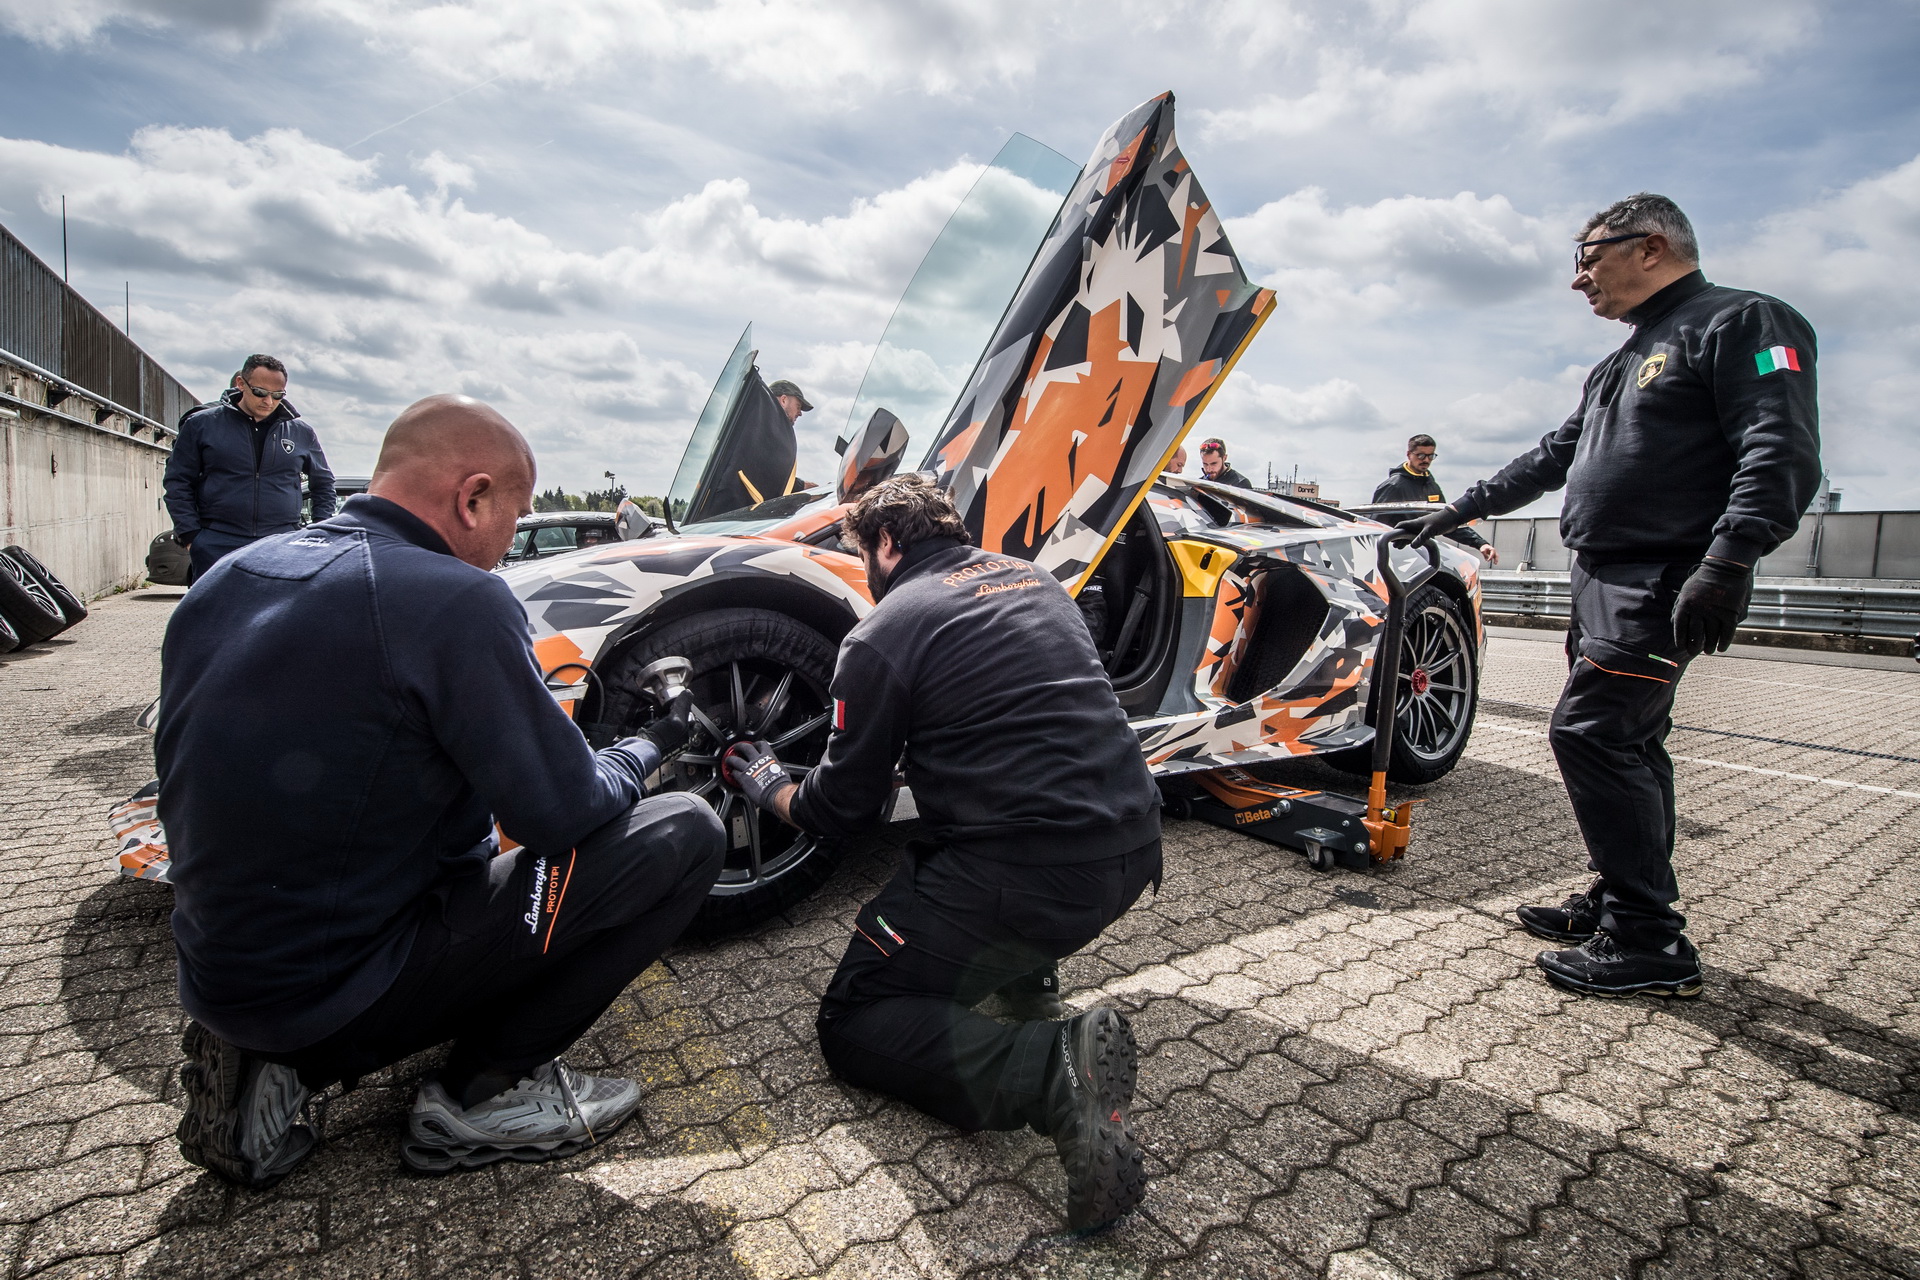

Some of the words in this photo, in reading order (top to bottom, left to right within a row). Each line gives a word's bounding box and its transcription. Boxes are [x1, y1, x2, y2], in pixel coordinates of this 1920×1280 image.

[943, 560, 1034, 588] PROTOTIPI
[974, 578, 1041, 597] Lamborghini
[745, 755, 772, 776] uvex
[1244, 809, 1272, 823] Beta
[524, 856, 548, 935] Lamborghin
[546, 866, 560, 913] PROTOTIPI
